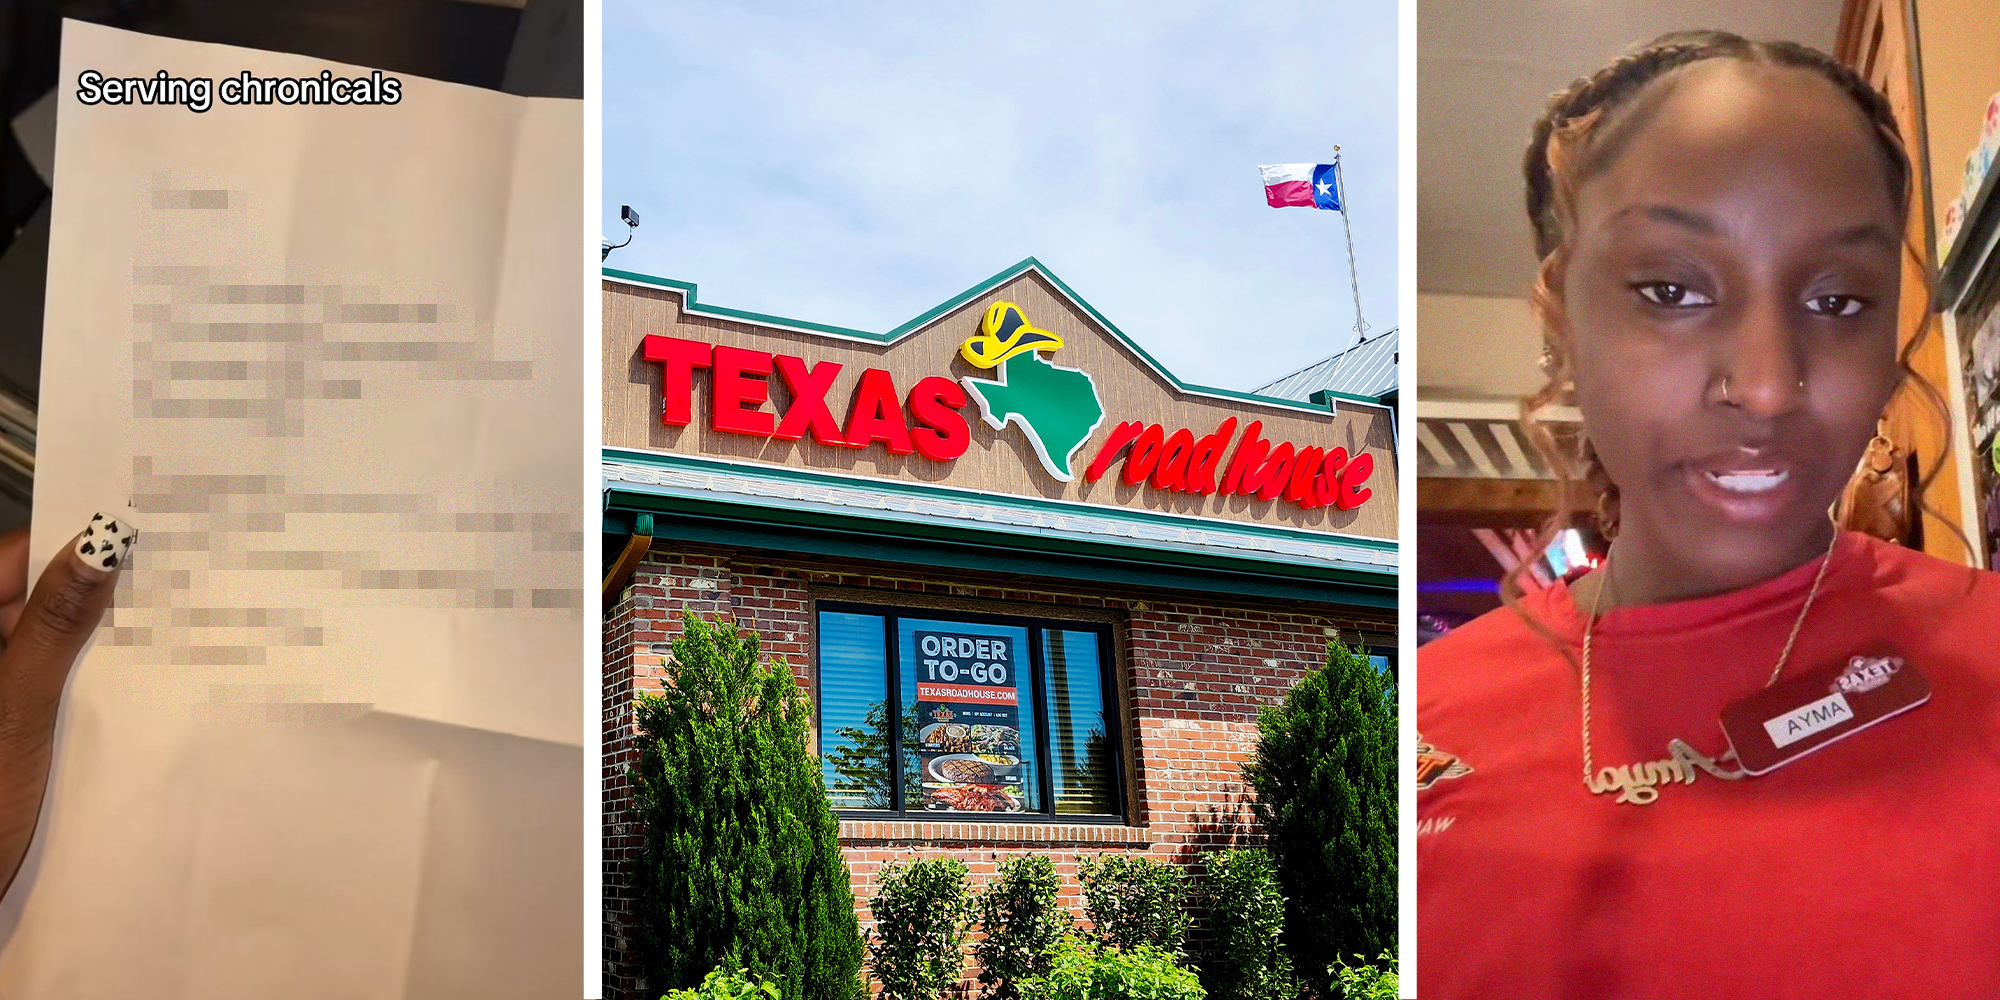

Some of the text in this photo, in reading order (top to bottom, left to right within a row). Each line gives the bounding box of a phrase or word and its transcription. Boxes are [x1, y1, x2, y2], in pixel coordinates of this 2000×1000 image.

[643, 334, 970, 461] TEXAS
[921, 635, 1007, 661] ORDER
[923, 659, 1007, 684] TO-GO
[920, 687, 1015, 700] TEXASROADHOUSE.COM
